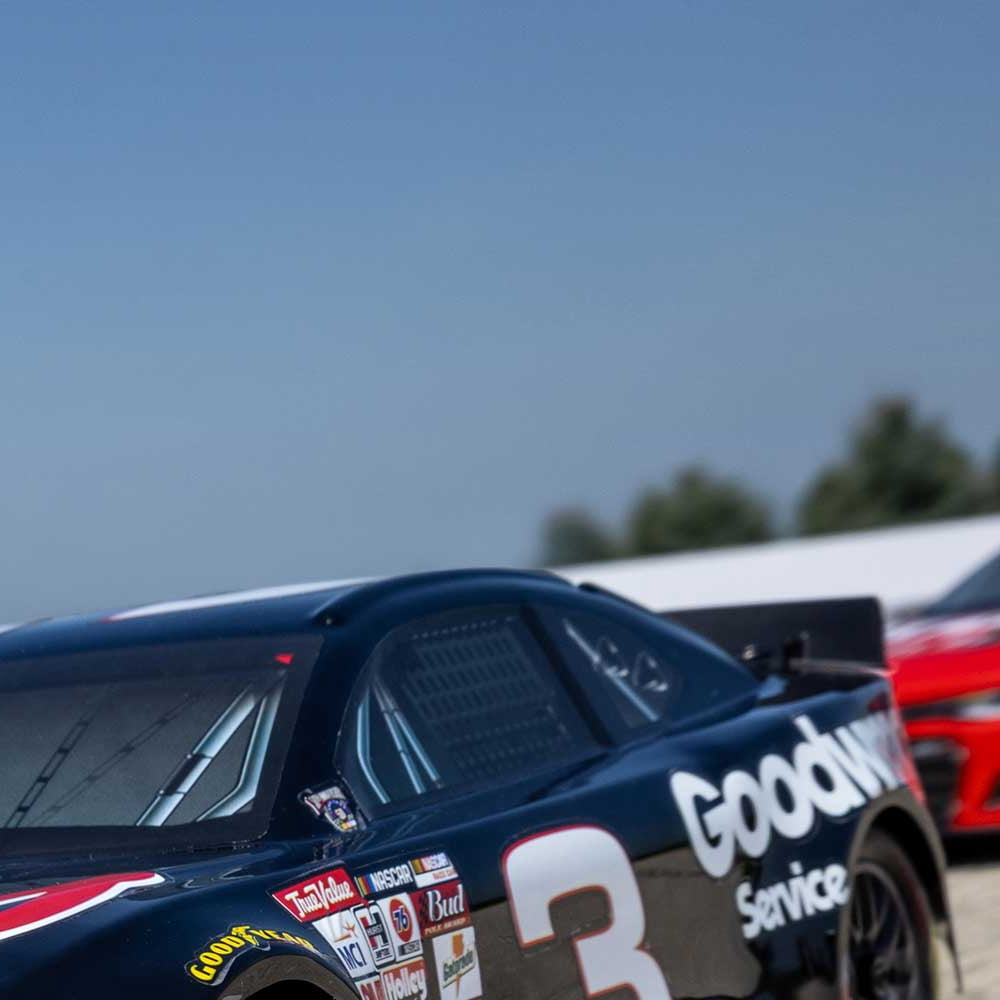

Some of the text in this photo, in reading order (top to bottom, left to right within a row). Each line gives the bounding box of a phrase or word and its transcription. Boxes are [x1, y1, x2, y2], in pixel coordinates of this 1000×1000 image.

[370, 864, 413, 892] NASCAR
[426, 883, 465, 922] Bud
[737, 862, 849, 939] Service
[393, 906, 409, 934] 76
[338, 942, 367, 970] MCI
[384, 967, 427, 1000] Holley
